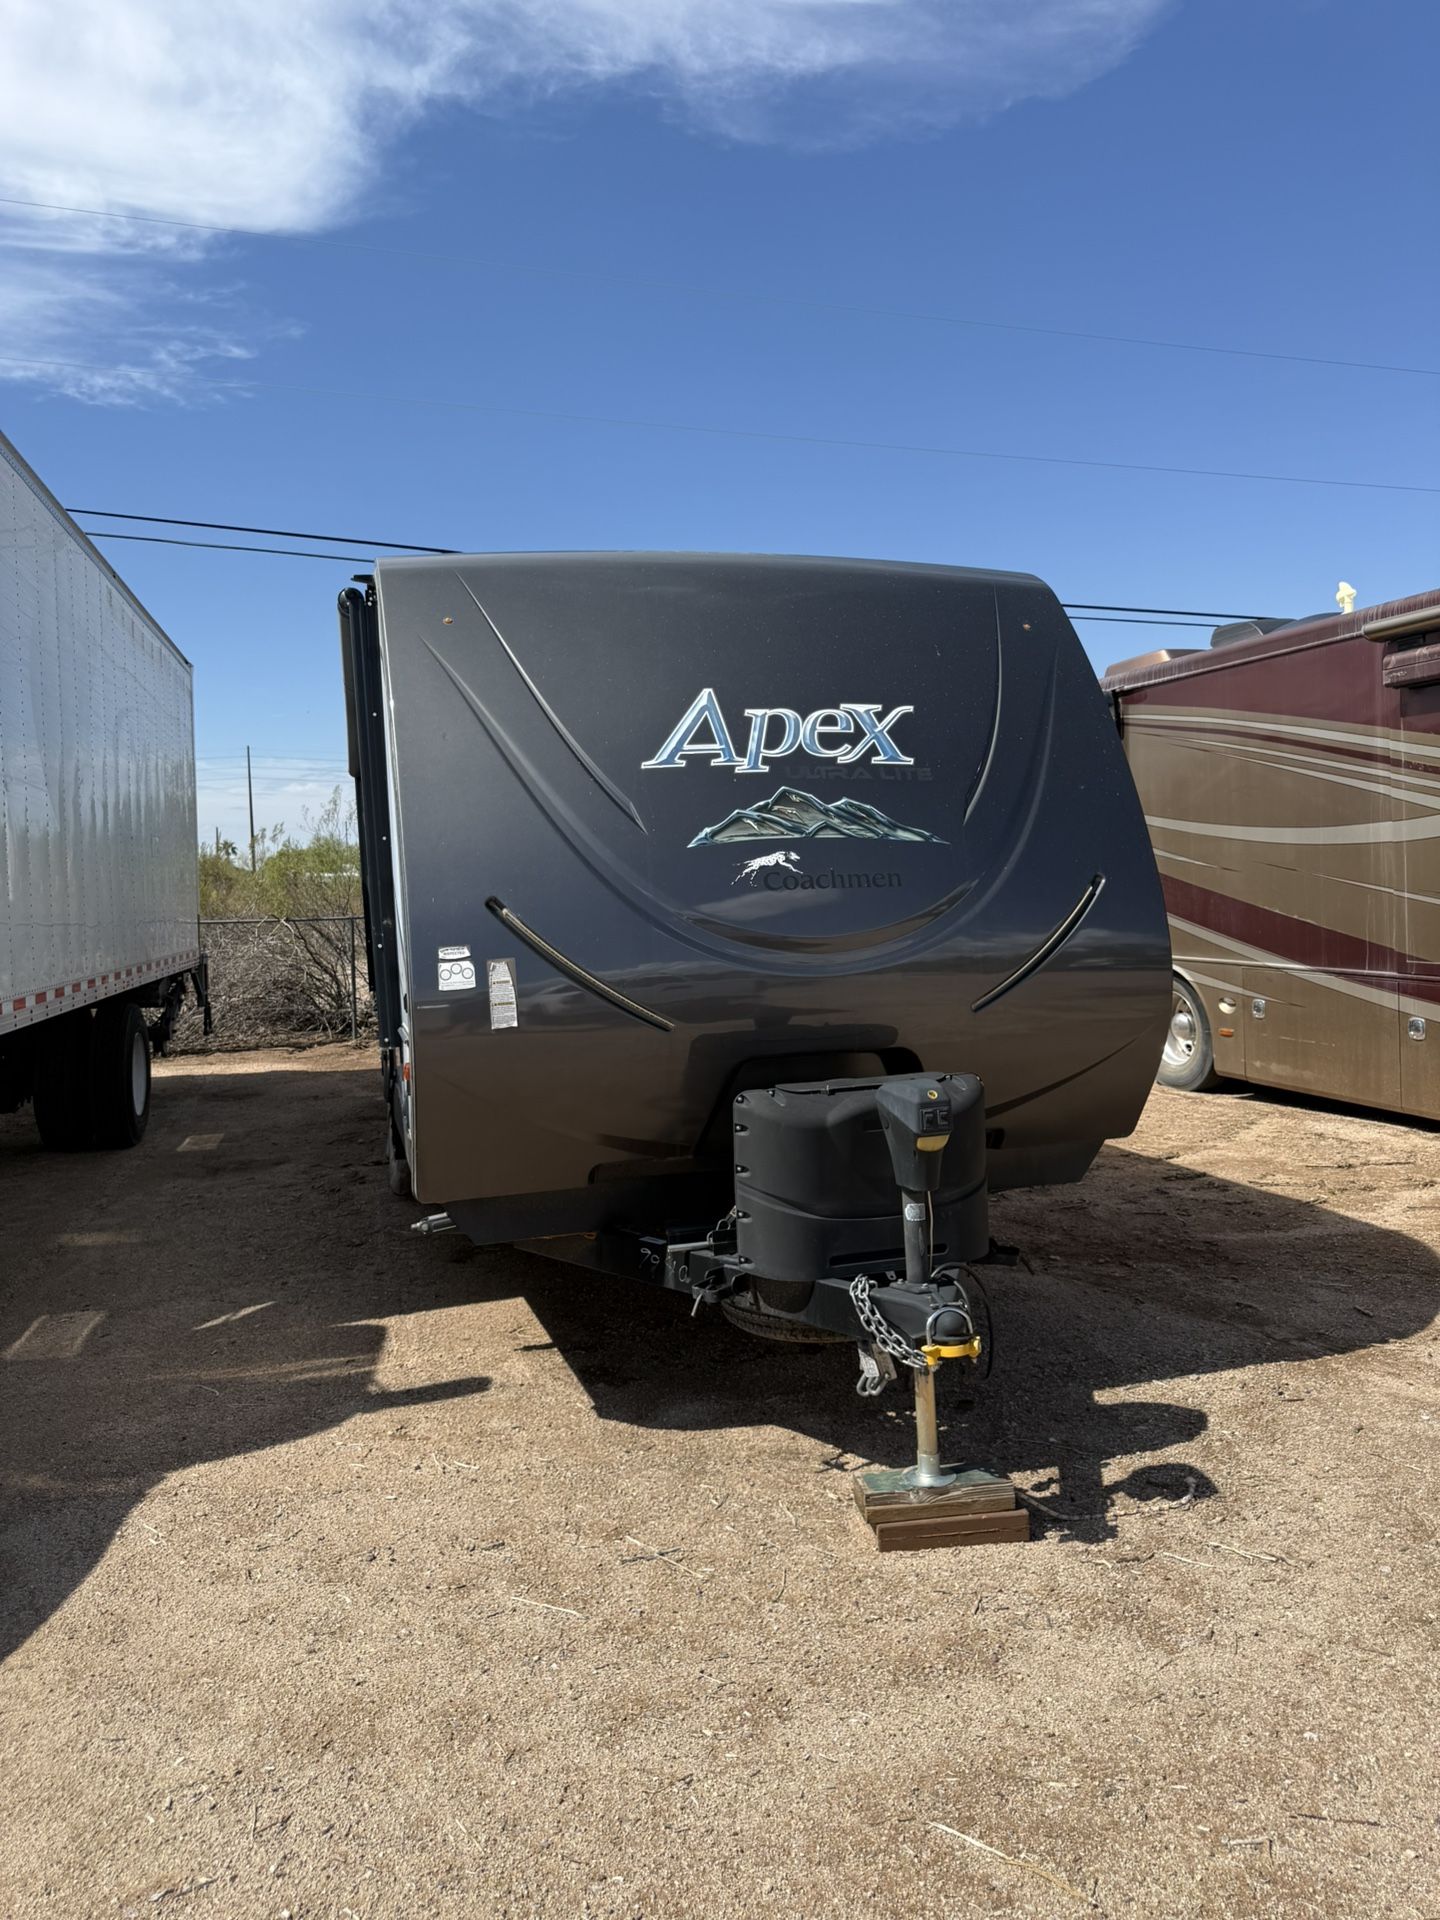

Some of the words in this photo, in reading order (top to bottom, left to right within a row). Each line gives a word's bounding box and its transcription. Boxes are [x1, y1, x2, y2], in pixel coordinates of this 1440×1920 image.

[641, 688, 914, 773] Apex
[784, 766, 875, 781] ULTRA
[879, 767, 934, 781] LITE
[763, 869, 902, 891] Coachmen
